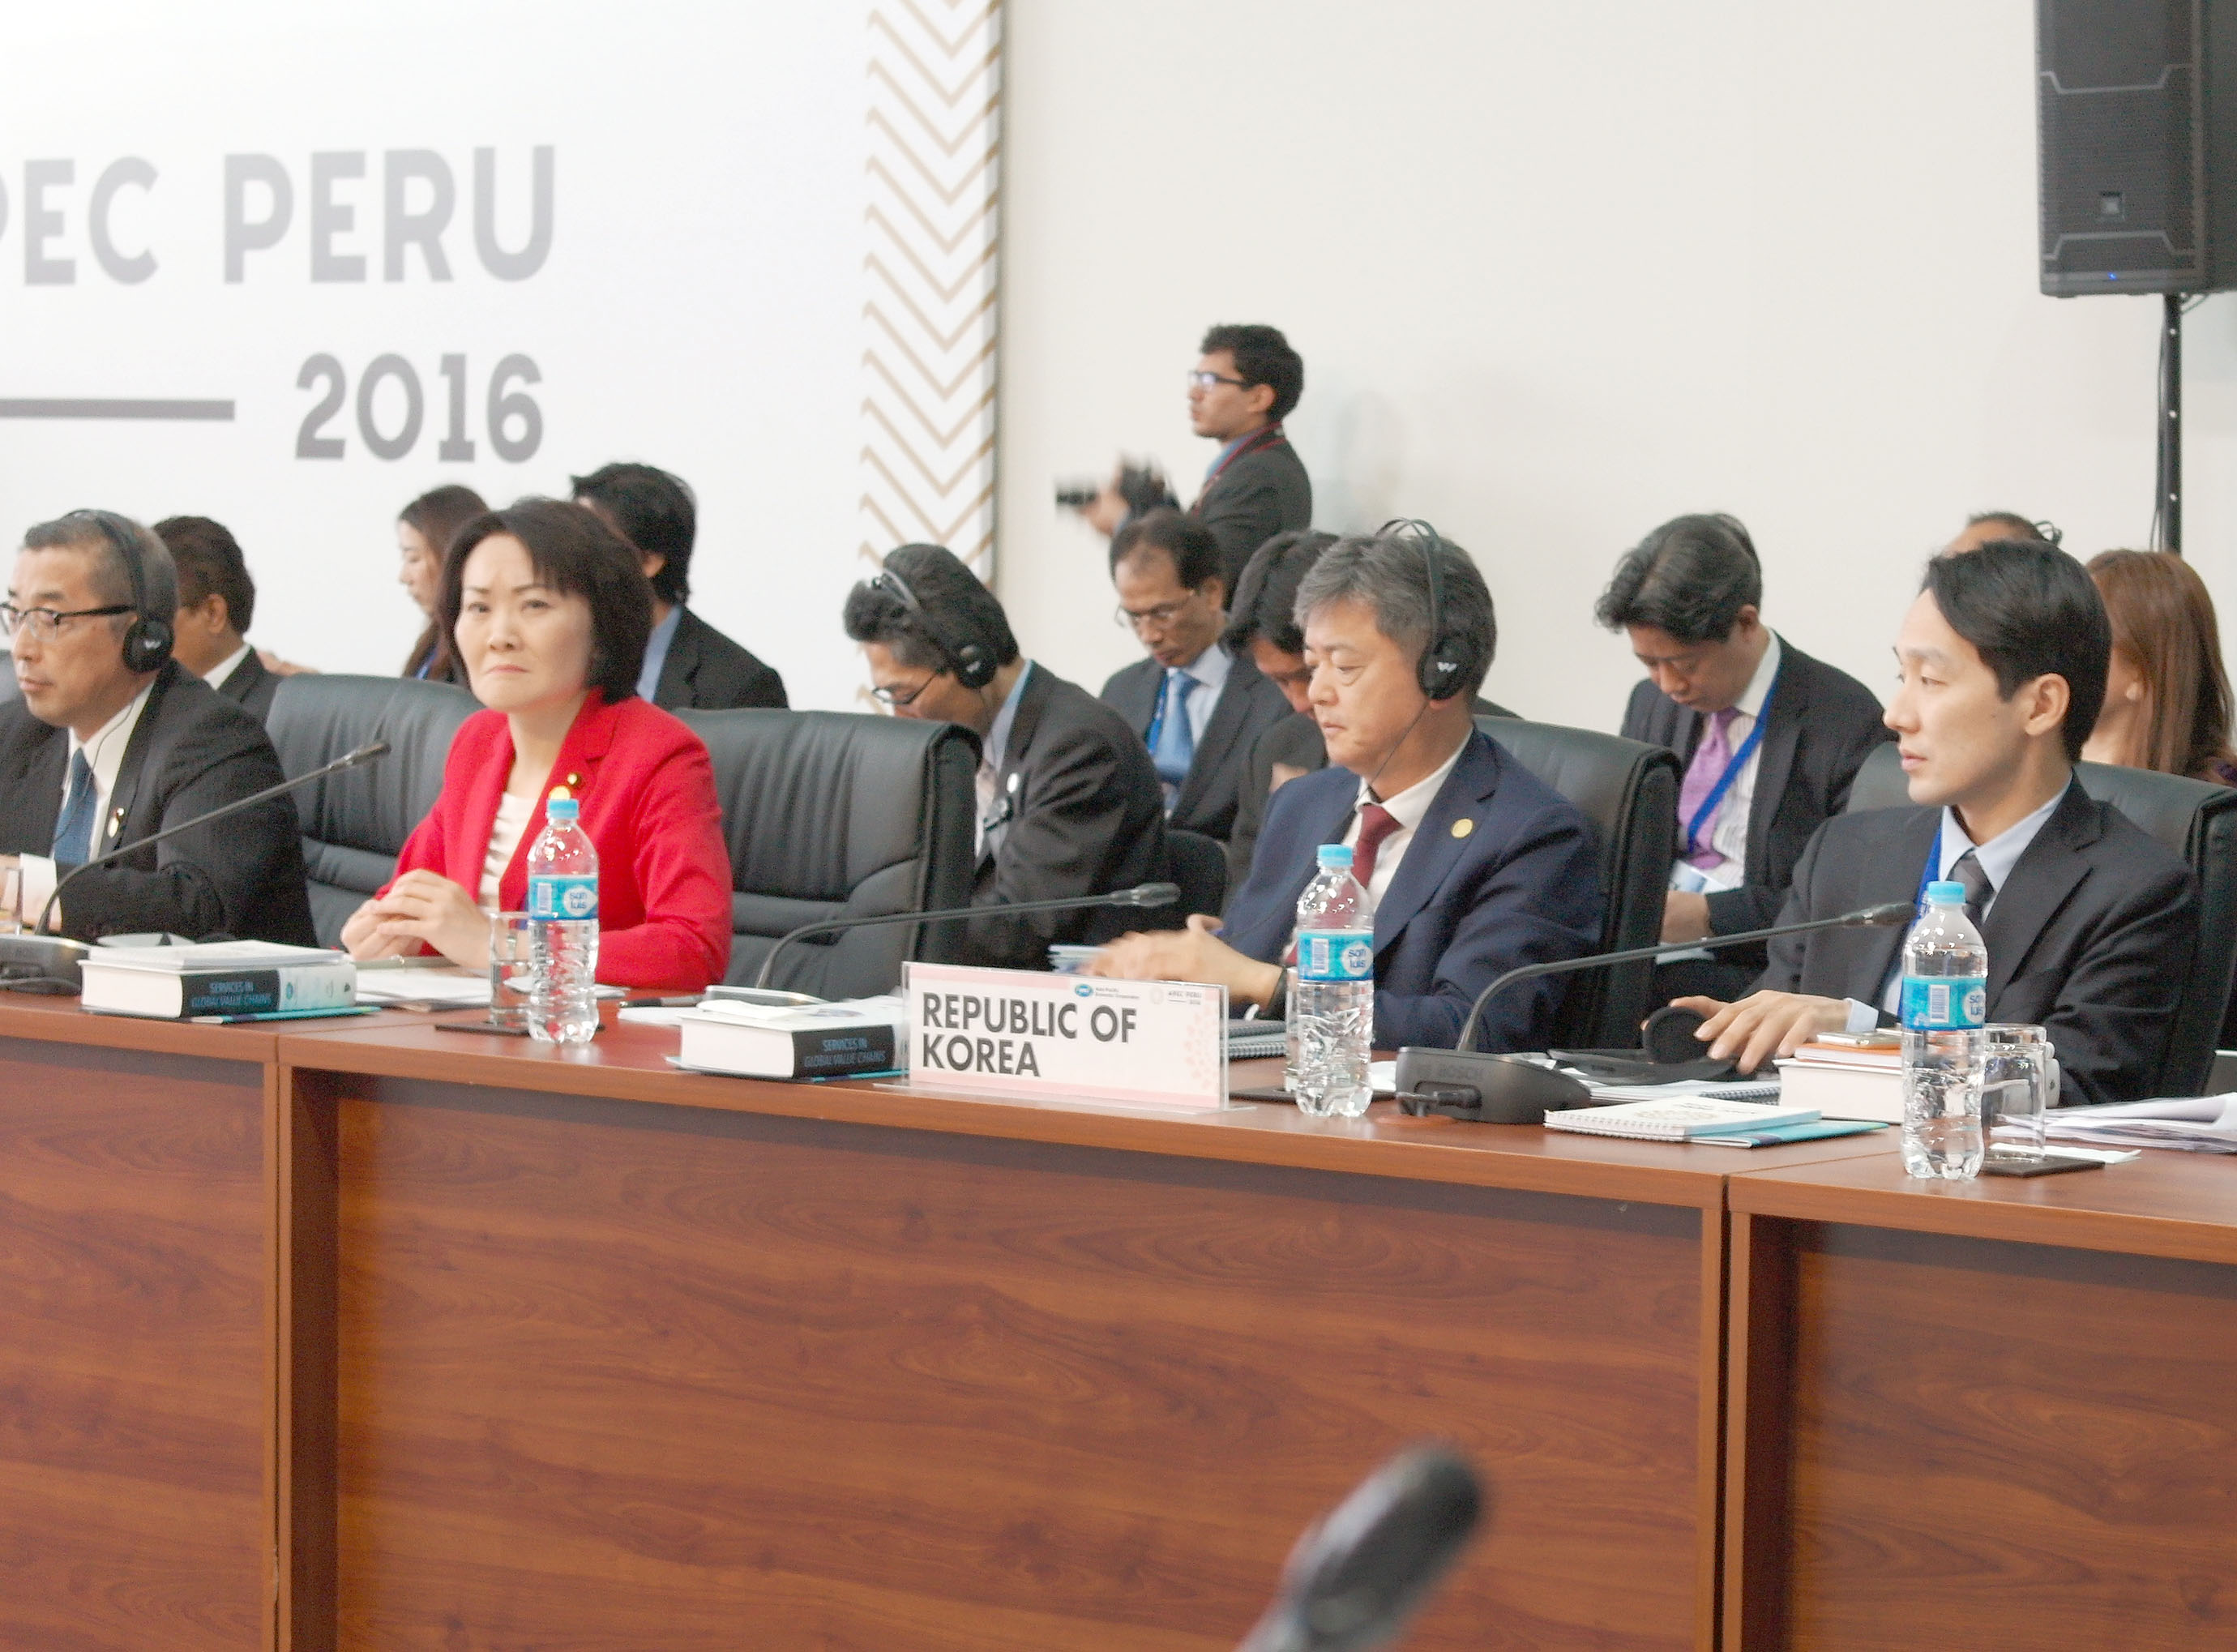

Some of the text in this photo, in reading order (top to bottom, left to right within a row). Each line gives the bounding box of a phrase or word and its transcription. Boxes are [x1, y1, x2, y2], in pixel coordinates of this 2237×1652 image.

[0, 145, 555, 286] EC PERU
[295, 353, 544, 463] 2016
[1348, 948, 1366, 957] san
[922, 991, 1136, 1043] REPUBLIC OF
[922, 1033, 1042, 1077] KOREA
